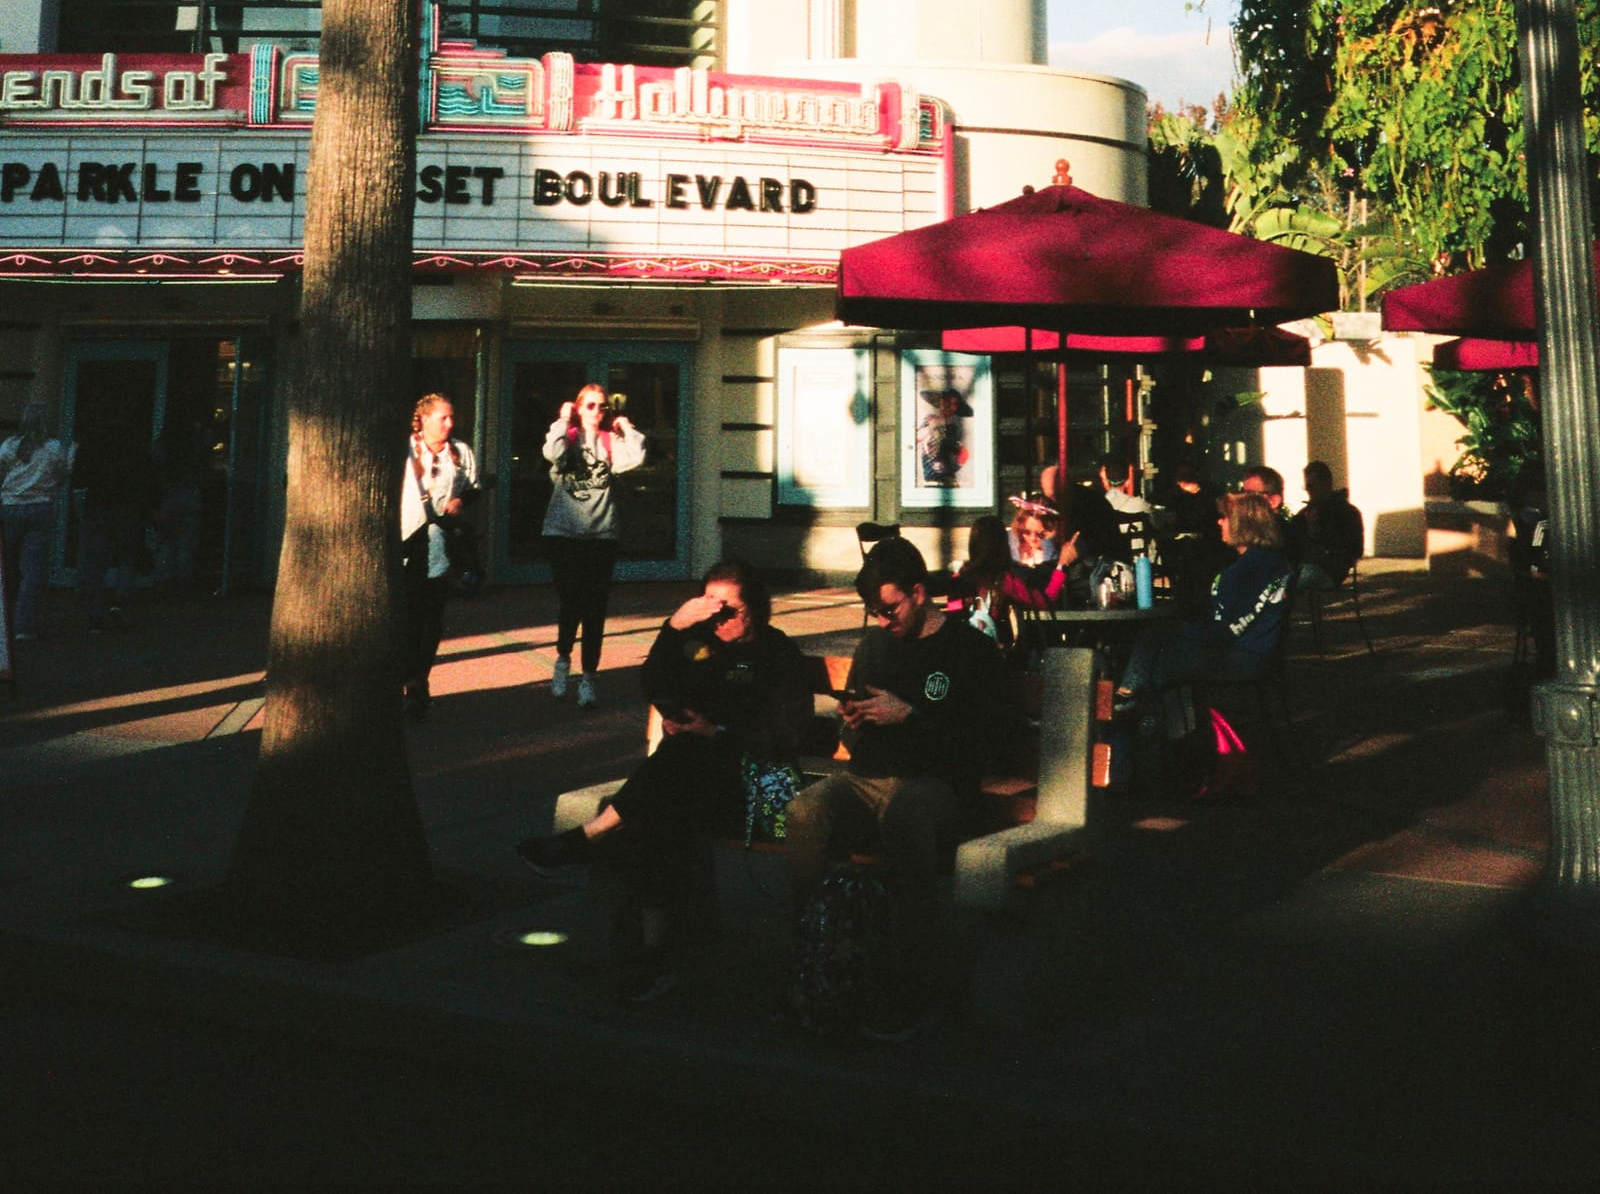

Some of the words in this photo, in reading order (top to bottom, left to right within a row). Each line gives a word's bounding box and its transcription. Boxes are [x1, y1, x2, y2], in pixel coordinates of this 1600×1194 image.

[163, 52, 230, 110] of
[594, 63, 880, 139] Hollywood
[1, 161, 204, 204] PARKLE
[229, 162, 295, 203] ON
[415, 164, 504, 206] SET
[532, 168, 819, 214] BOULEVARD
